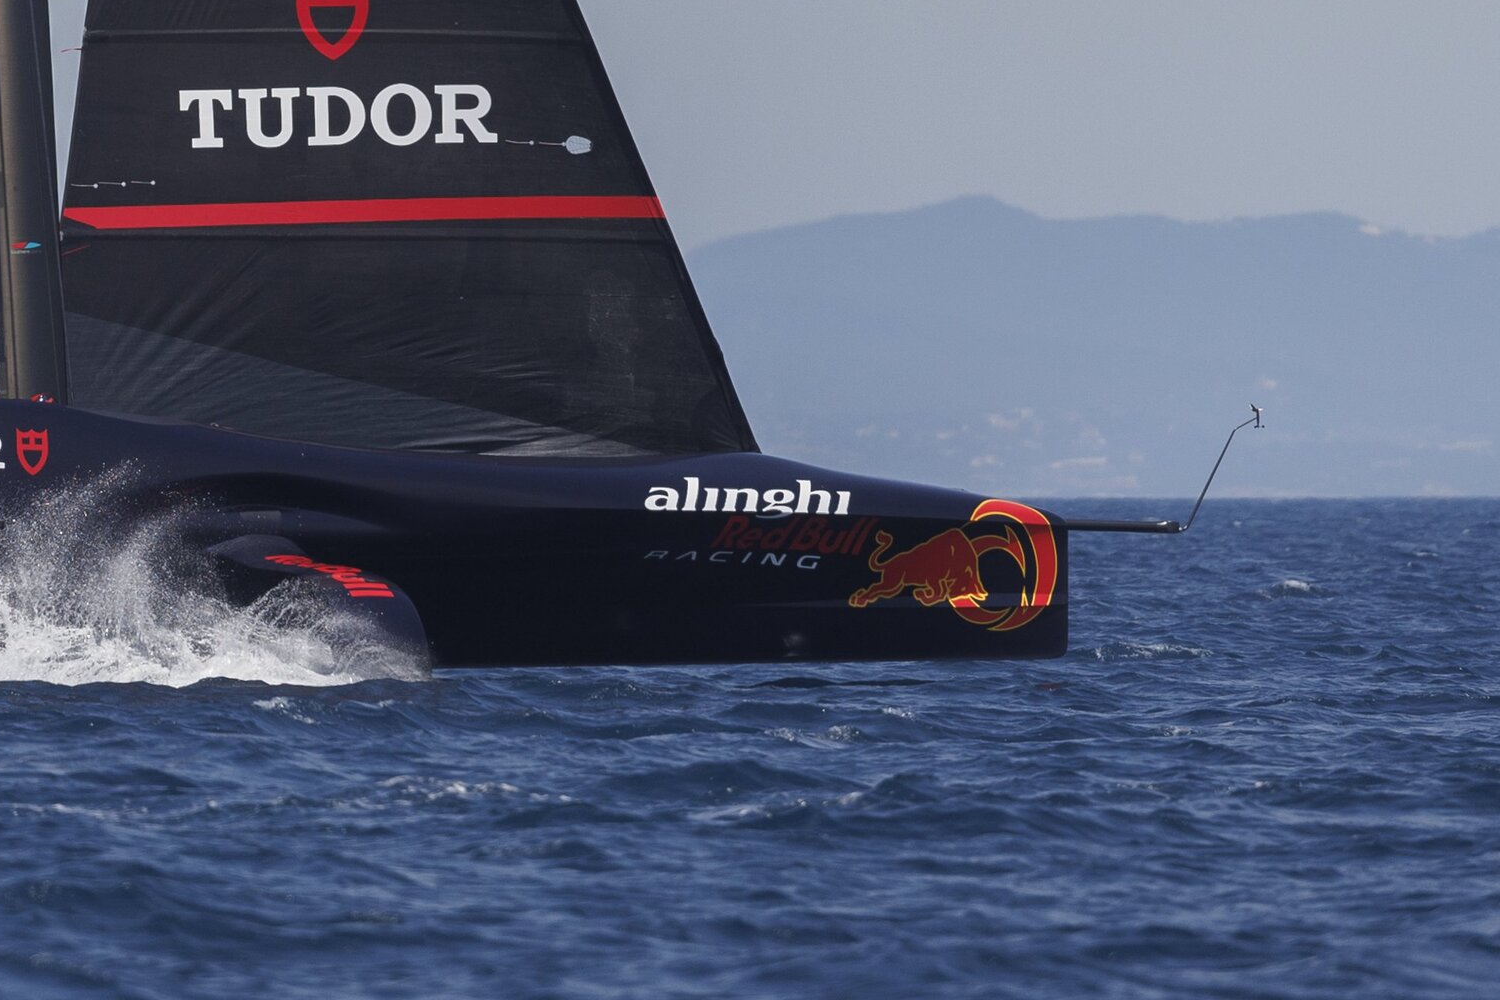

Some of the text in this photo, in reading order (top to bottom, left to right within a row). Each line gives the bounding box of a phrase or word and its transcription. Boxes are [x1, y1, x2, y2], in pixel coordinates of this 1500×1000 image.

[179, 83, 498, 148] TUDOR
[644, 477, 851, 519] alinghi
[710, 516, 875, 555] Red Bull
[644, 550, 821, 570] RACING
